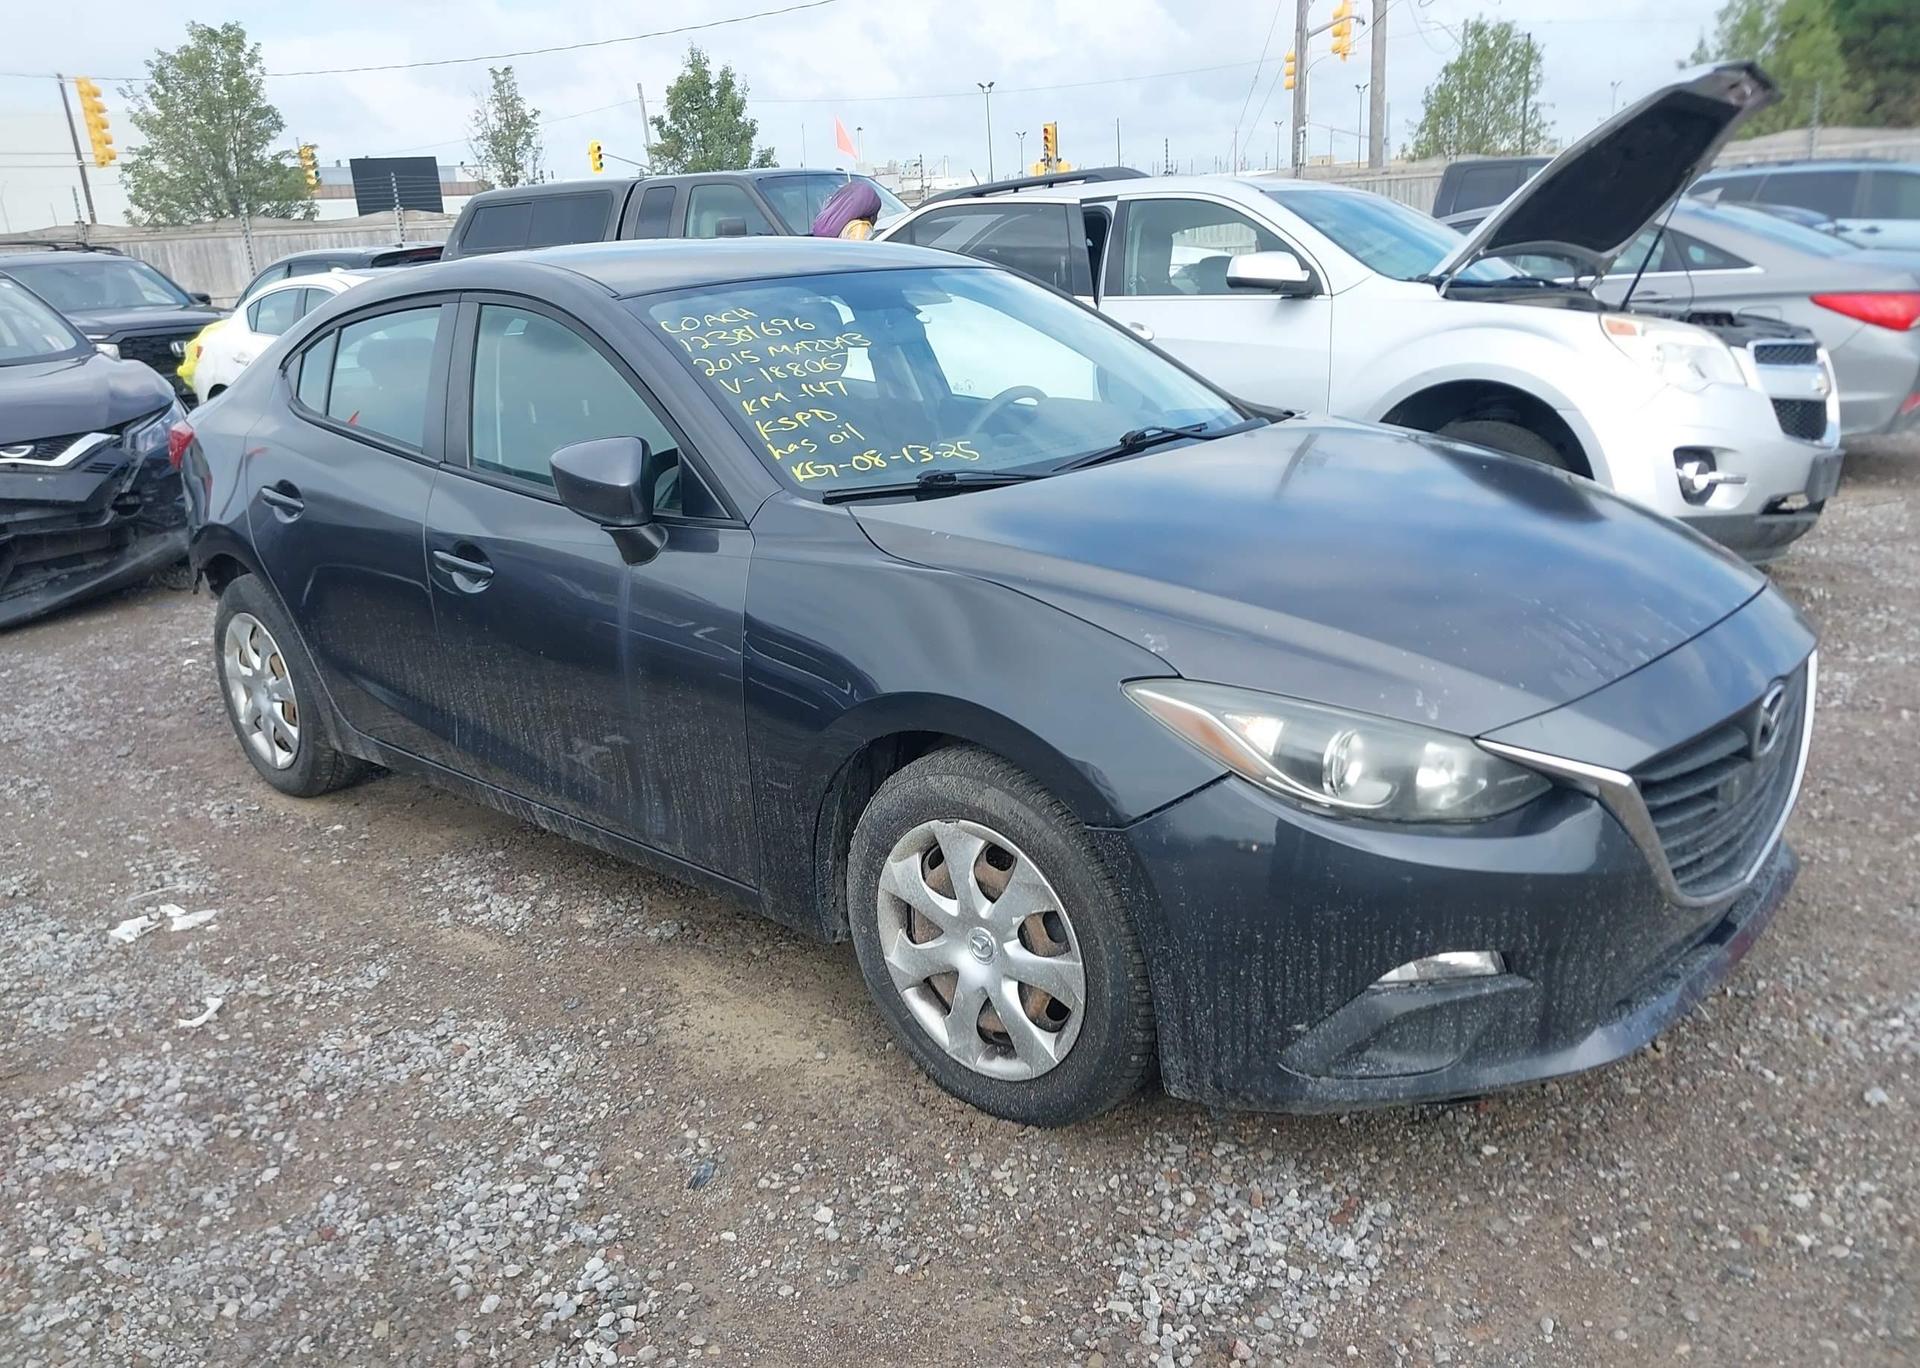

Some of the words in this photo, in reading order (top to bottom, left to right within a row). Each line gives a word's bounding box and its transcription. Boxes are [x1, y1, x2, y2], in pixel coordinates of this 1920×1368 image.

[661, 307, 758, 334] COACH
[679, 316, 816, 353] 12381696
[693, 349, 761, 377] 2015
[755, 408, 838, 441] KSPD
[766, 438, 818, 460] has
[829, 422, 865, 444] oil
